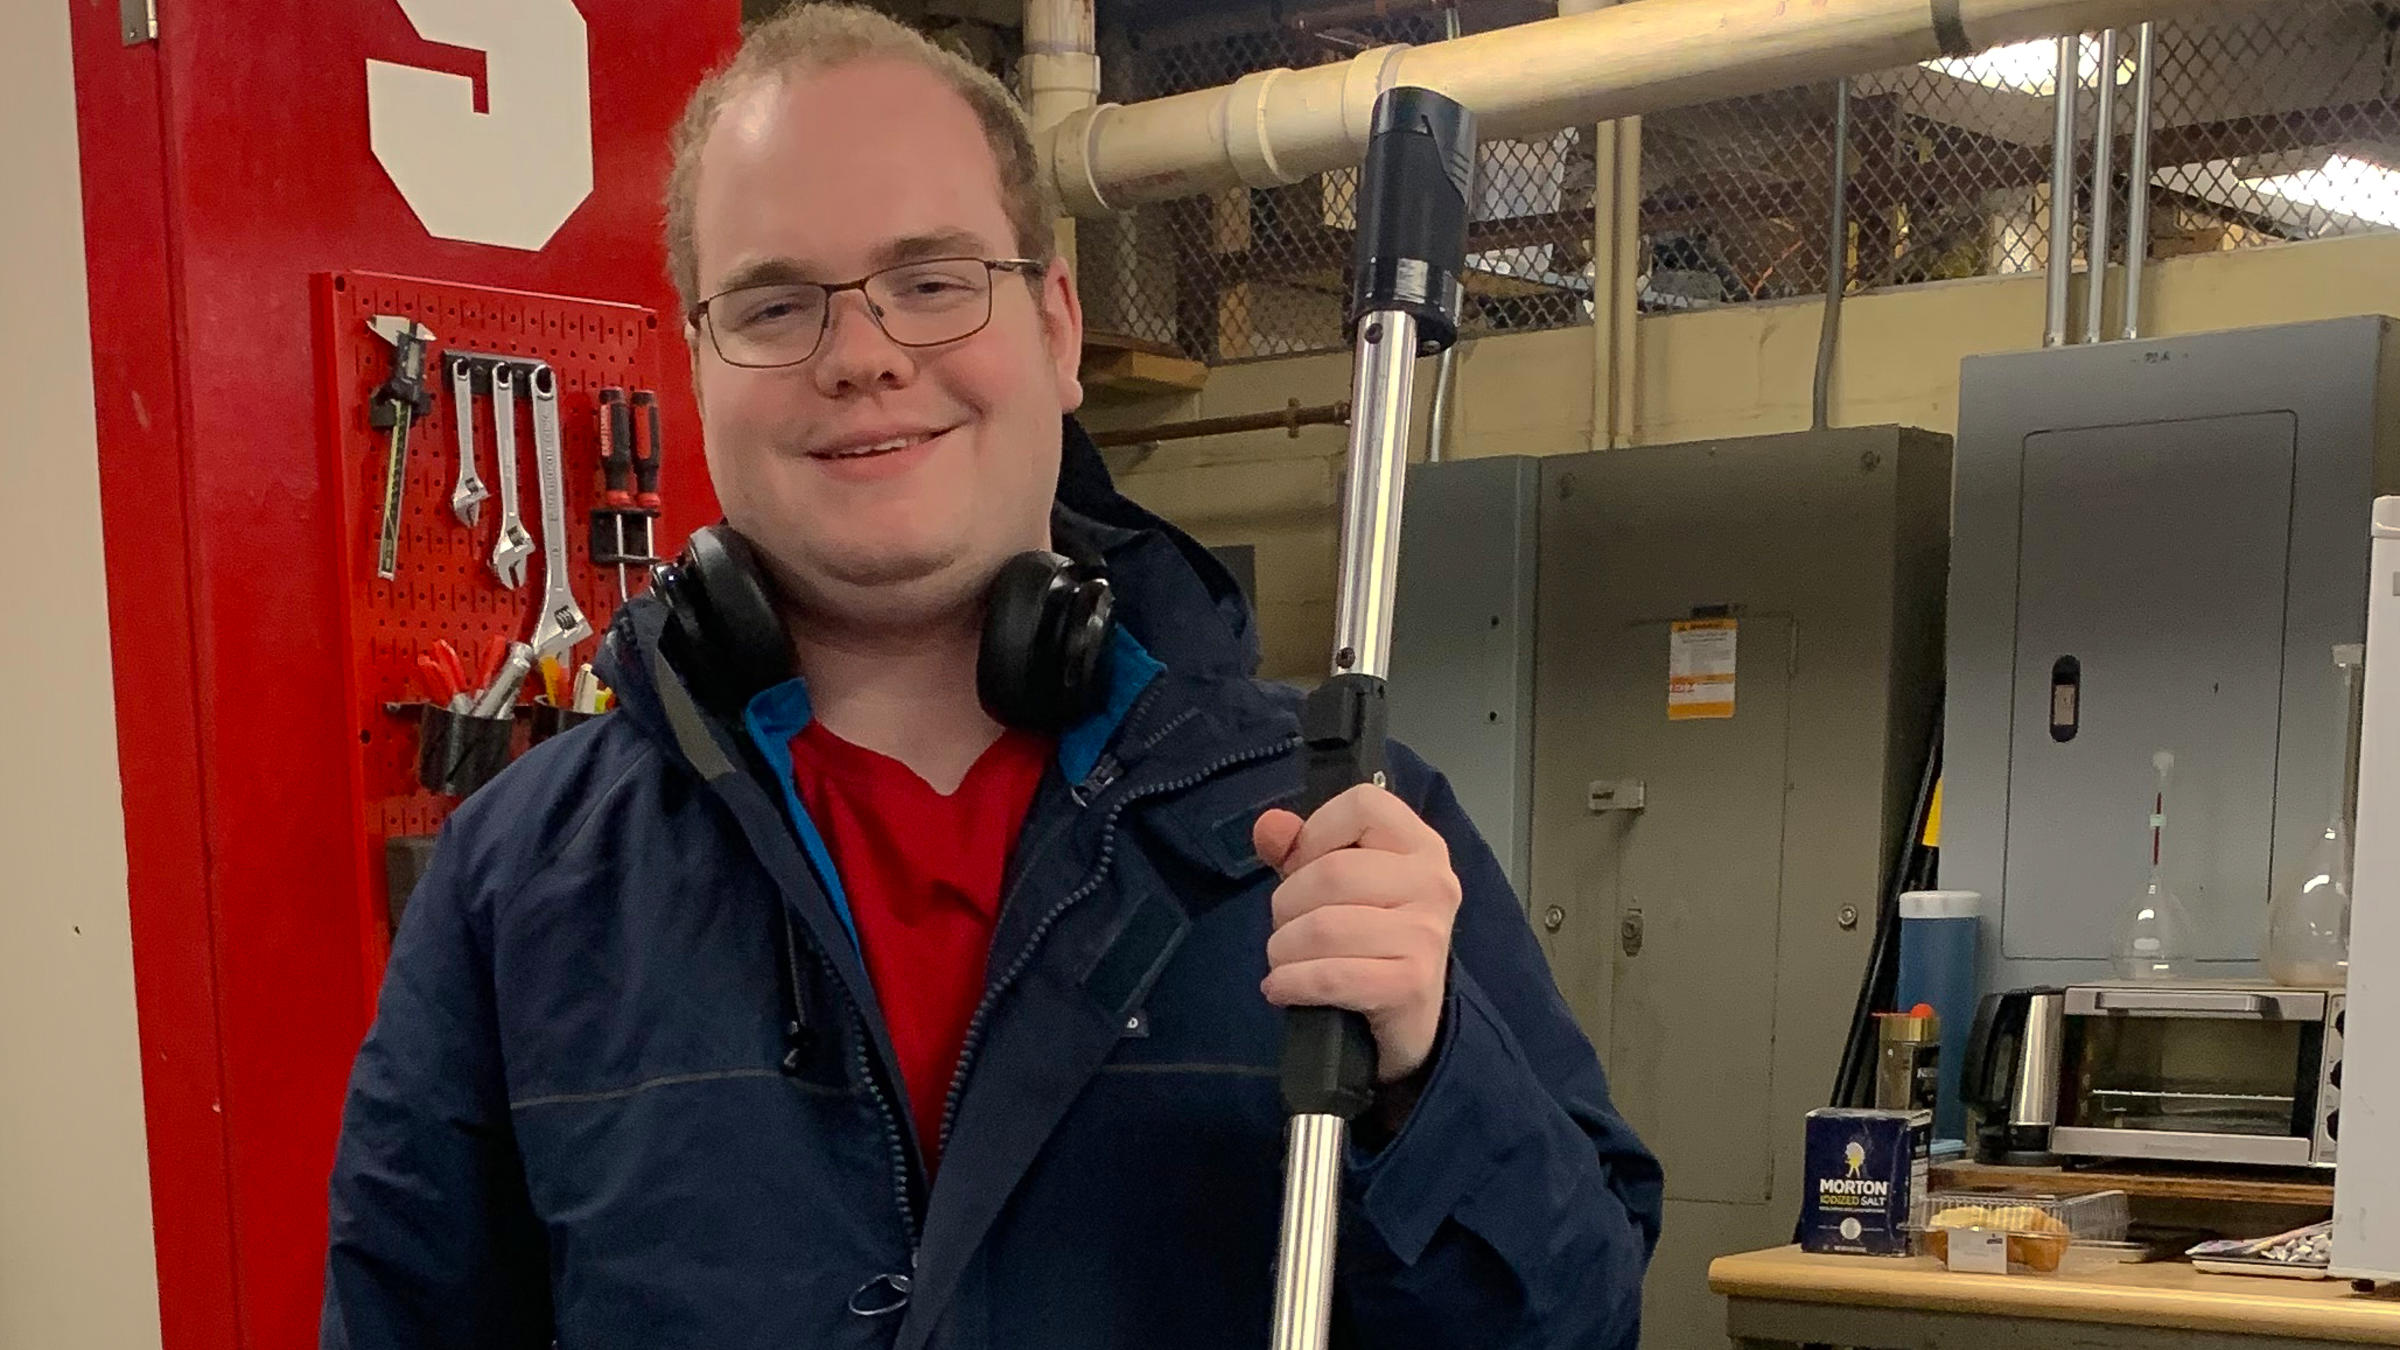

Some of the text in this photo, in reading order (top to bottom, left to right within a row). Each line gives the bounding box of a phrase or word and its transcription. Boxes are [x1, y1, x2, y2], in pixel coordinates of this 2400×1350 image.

[1820, 1179, 1888, 1195] MORTON
[1820, 1195, 1885, 1207] IODIZED SALT
